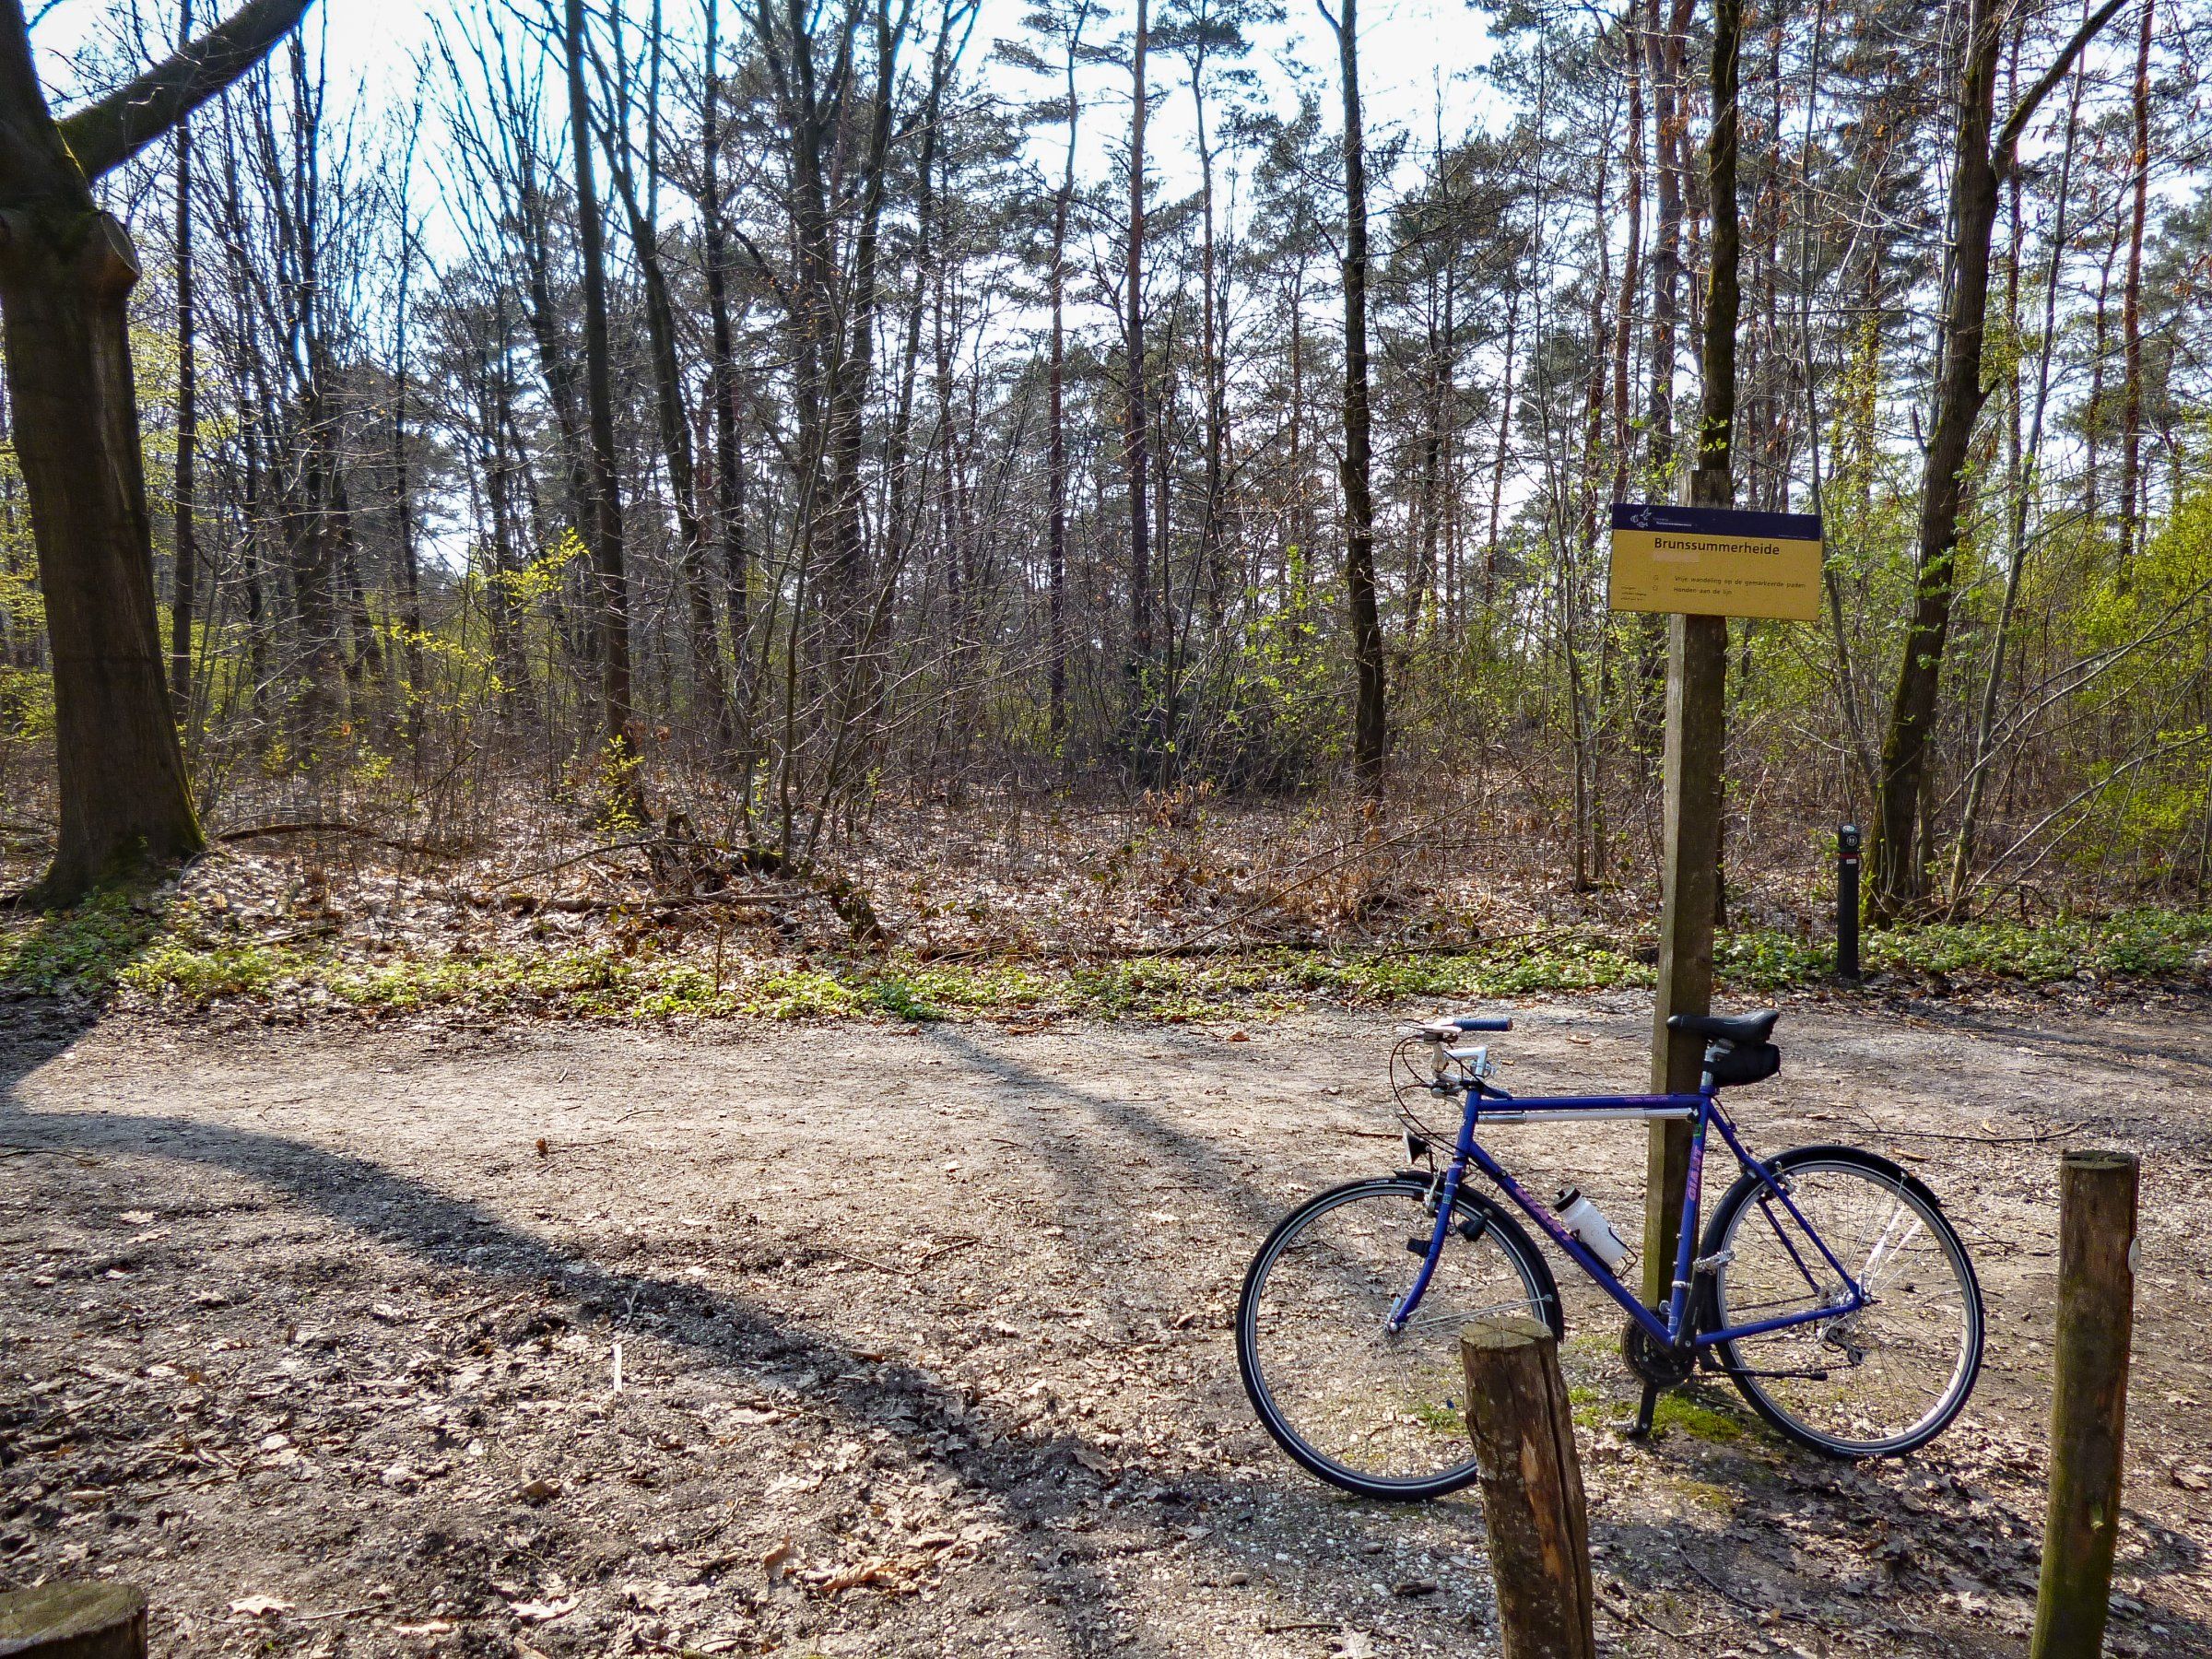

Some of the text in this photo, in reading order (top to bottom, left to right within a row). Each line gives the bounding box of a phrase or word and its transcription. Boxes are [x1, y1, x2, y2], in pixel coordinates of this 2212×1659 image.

[1654, 537, 1781, 556] Brunssummerheide
[1690, 576, 1722, 585] wandeling
[1744, 580, 1785, 588] gemarkeerde
[1688, 1145, 1703, 1202] GIANT
